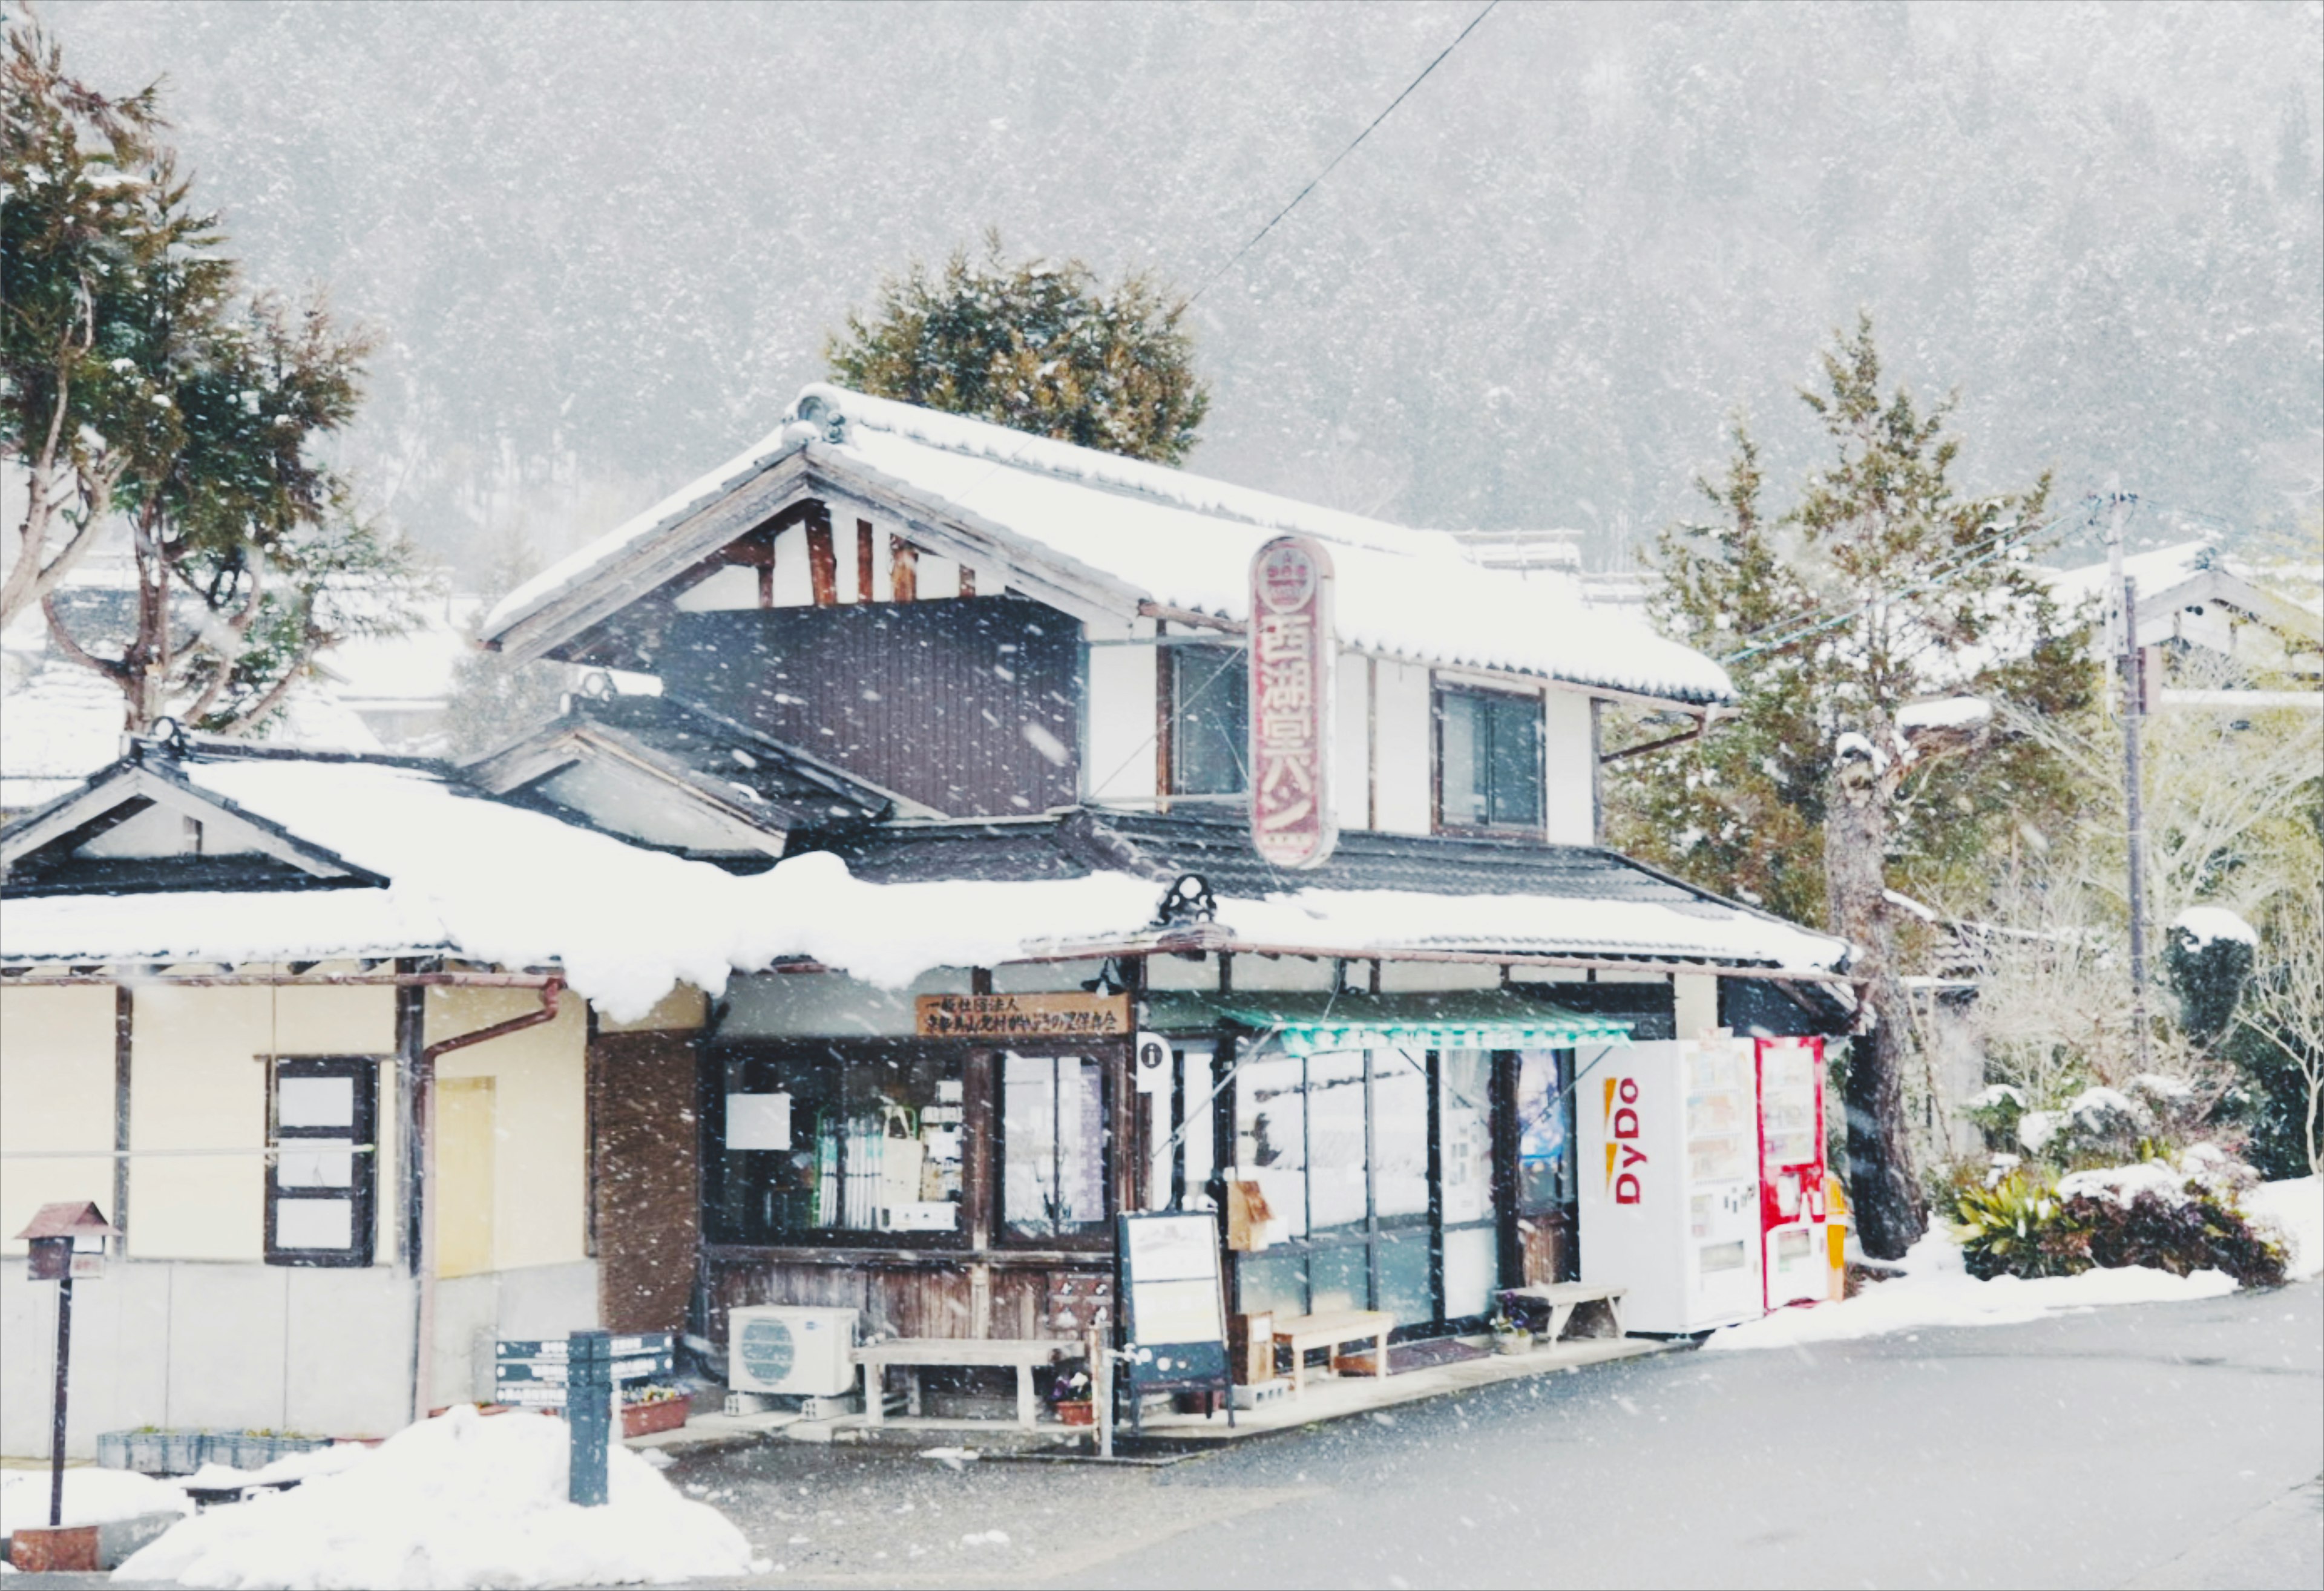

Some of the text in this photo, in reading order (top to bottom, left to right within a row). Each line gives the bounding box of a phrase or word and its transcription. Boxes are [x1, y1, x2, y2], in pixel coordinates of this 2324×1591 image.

[1259, 613, 1312, 832] 西湖堂パン
[926, 996, 1019, 1012] 一般社団法人
[1614, 1077, 1648, 1204] DyDo
